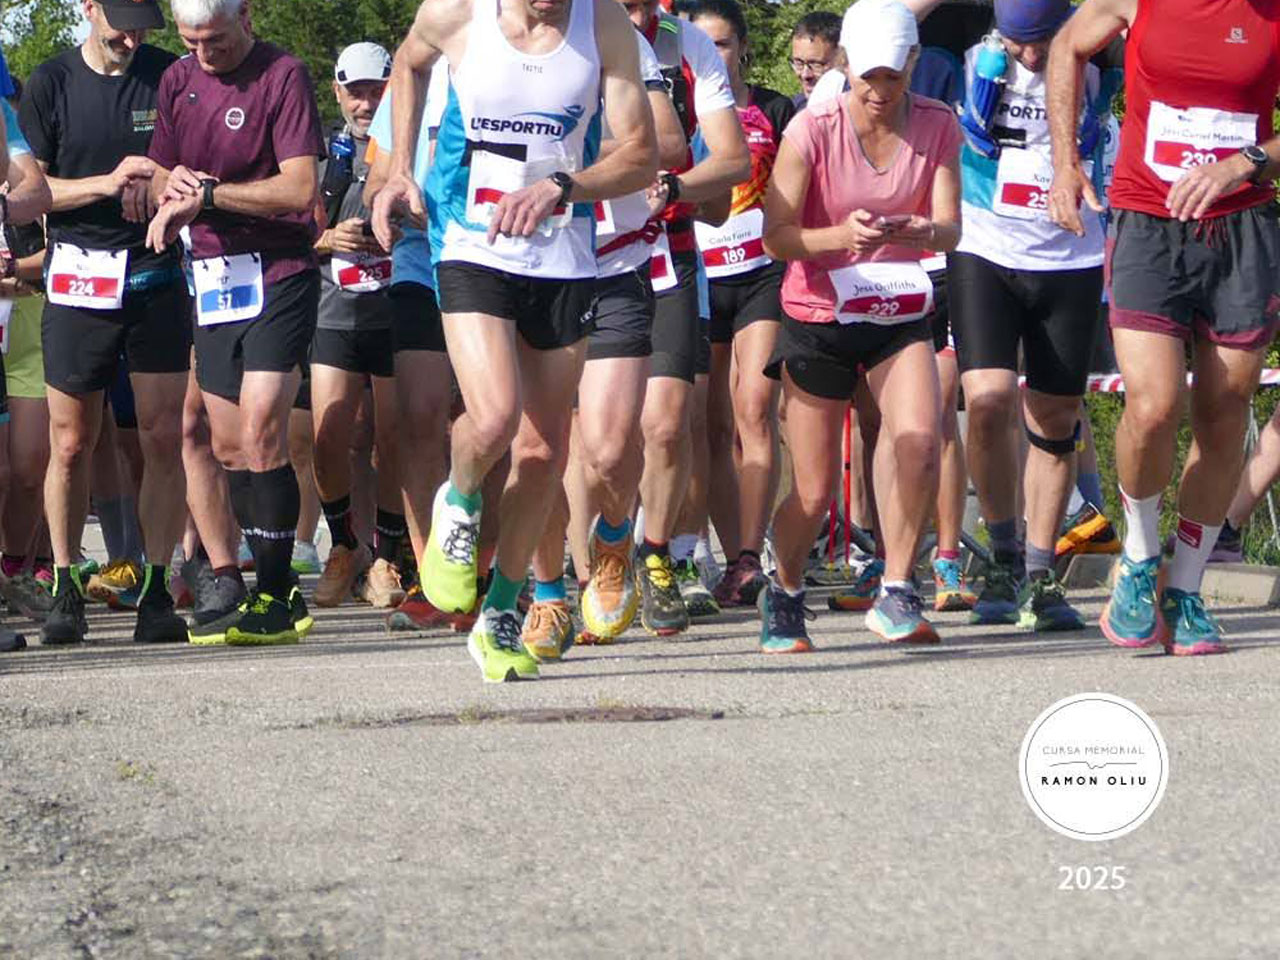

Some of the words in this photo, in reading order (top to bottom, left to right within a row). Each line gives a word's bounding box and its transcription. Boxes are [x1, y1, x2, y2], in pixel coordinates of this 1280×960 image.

[470, 117, 563, 137] L'ESPORTIU
[722, 247, 746, 265] 189
[358, 266, 383, 283] 225
[68, 280, 95, 296] 224
[217, 293, 232, 311] 57
[869, 301, 900, 316] 229
